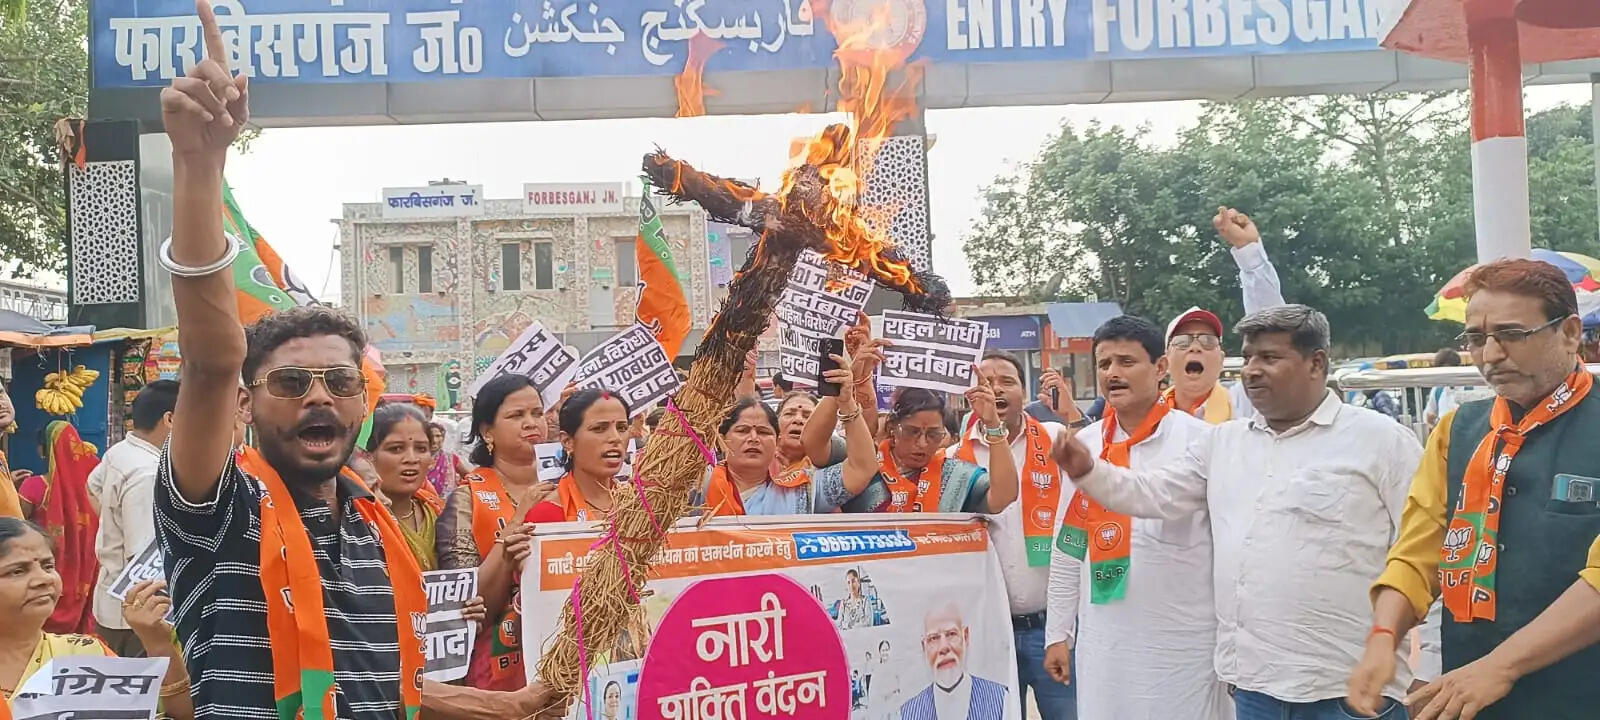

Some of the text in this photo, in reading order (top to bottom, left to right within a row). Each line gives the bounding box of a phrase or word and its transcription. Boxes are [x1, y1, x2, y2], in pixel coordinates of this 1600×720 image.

[946, 0, 1067, 50] ENTRY
[1094, 0, 1383, 52] FORBESGA
[388, 191, 454, 209] फारबिसगंज
[528, 191, 618, 206] FORBESGANJ JN.
[885, 317, 982, 344] राहुल गांधी
[605, 346, 667, 386] गठबंधन
[782, 354, 820, 376] मुर्दाबा
[884, 349, 973, 379] मुर्दाबाद
[547, 551, 573, 575] नारी
[683, 547, 699, 563] का
[701, 541, 743, 561] समर्थन
[746, 537, 773, 558] करने
[775, 538, 792, 560] हेतु
[692, 592, 787, 667] नारी
[657, 670, 827, 720] शक्ति वंदन
